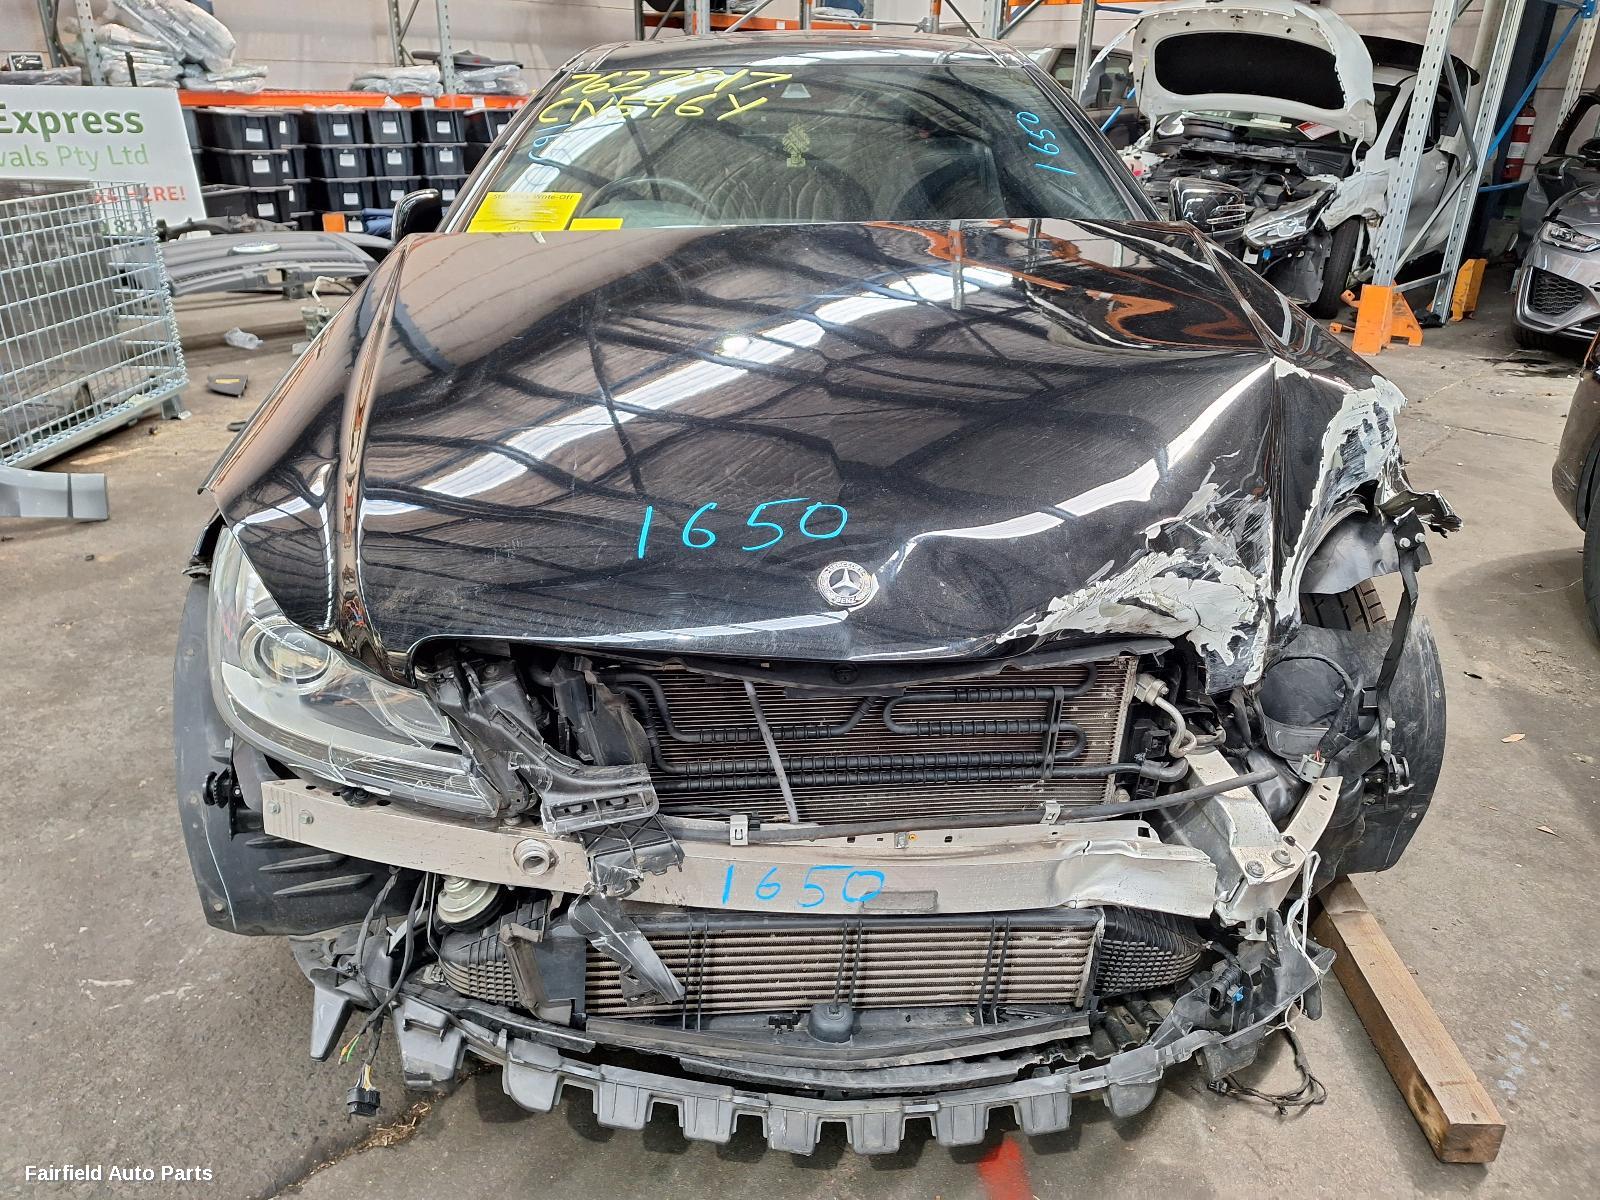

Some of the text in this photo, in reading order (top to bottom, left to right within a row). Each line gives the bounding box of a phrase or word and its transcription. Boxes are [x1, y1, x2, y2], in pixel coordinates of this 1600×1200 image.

[57, 145, 98, 171] Pty
[107, 144, 149, 166] Ltd
[1016, 111, 1077, 174] 1650
[638, 497, 849, 560] 1650
[722, 864, 886, 908] 1650
